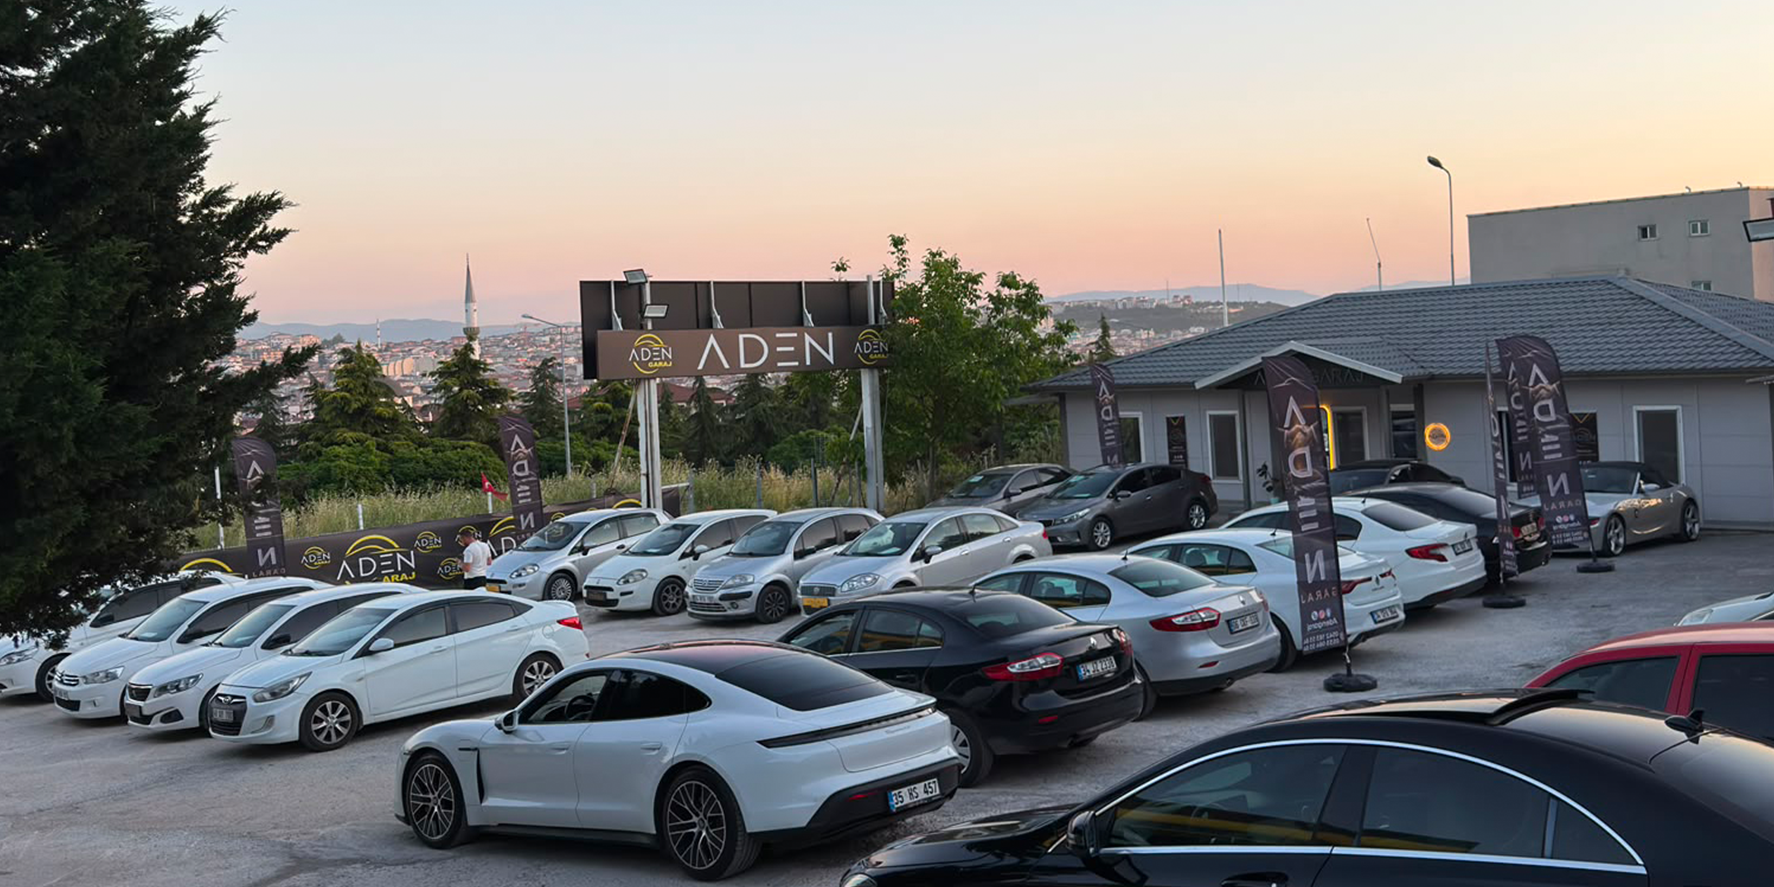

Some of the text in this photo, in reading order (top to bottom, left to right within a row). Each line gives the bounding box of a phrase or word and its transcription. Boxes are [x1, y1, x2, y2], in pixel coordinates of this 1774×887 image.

[628, 347, 672, 361] ADEN
[697, 332, 835, 370] ADEN
[854, 341, 888, 354] ADEN
[413, 536, 442, 548] ADEN
[301, 552, 331, 564] ADEN
[336, 550, 416, 581] ADEN
[383, 571, 416, 584] ARAJ
[894, 790, 905, 806] 35
[923, 780, 937, 796] 457
